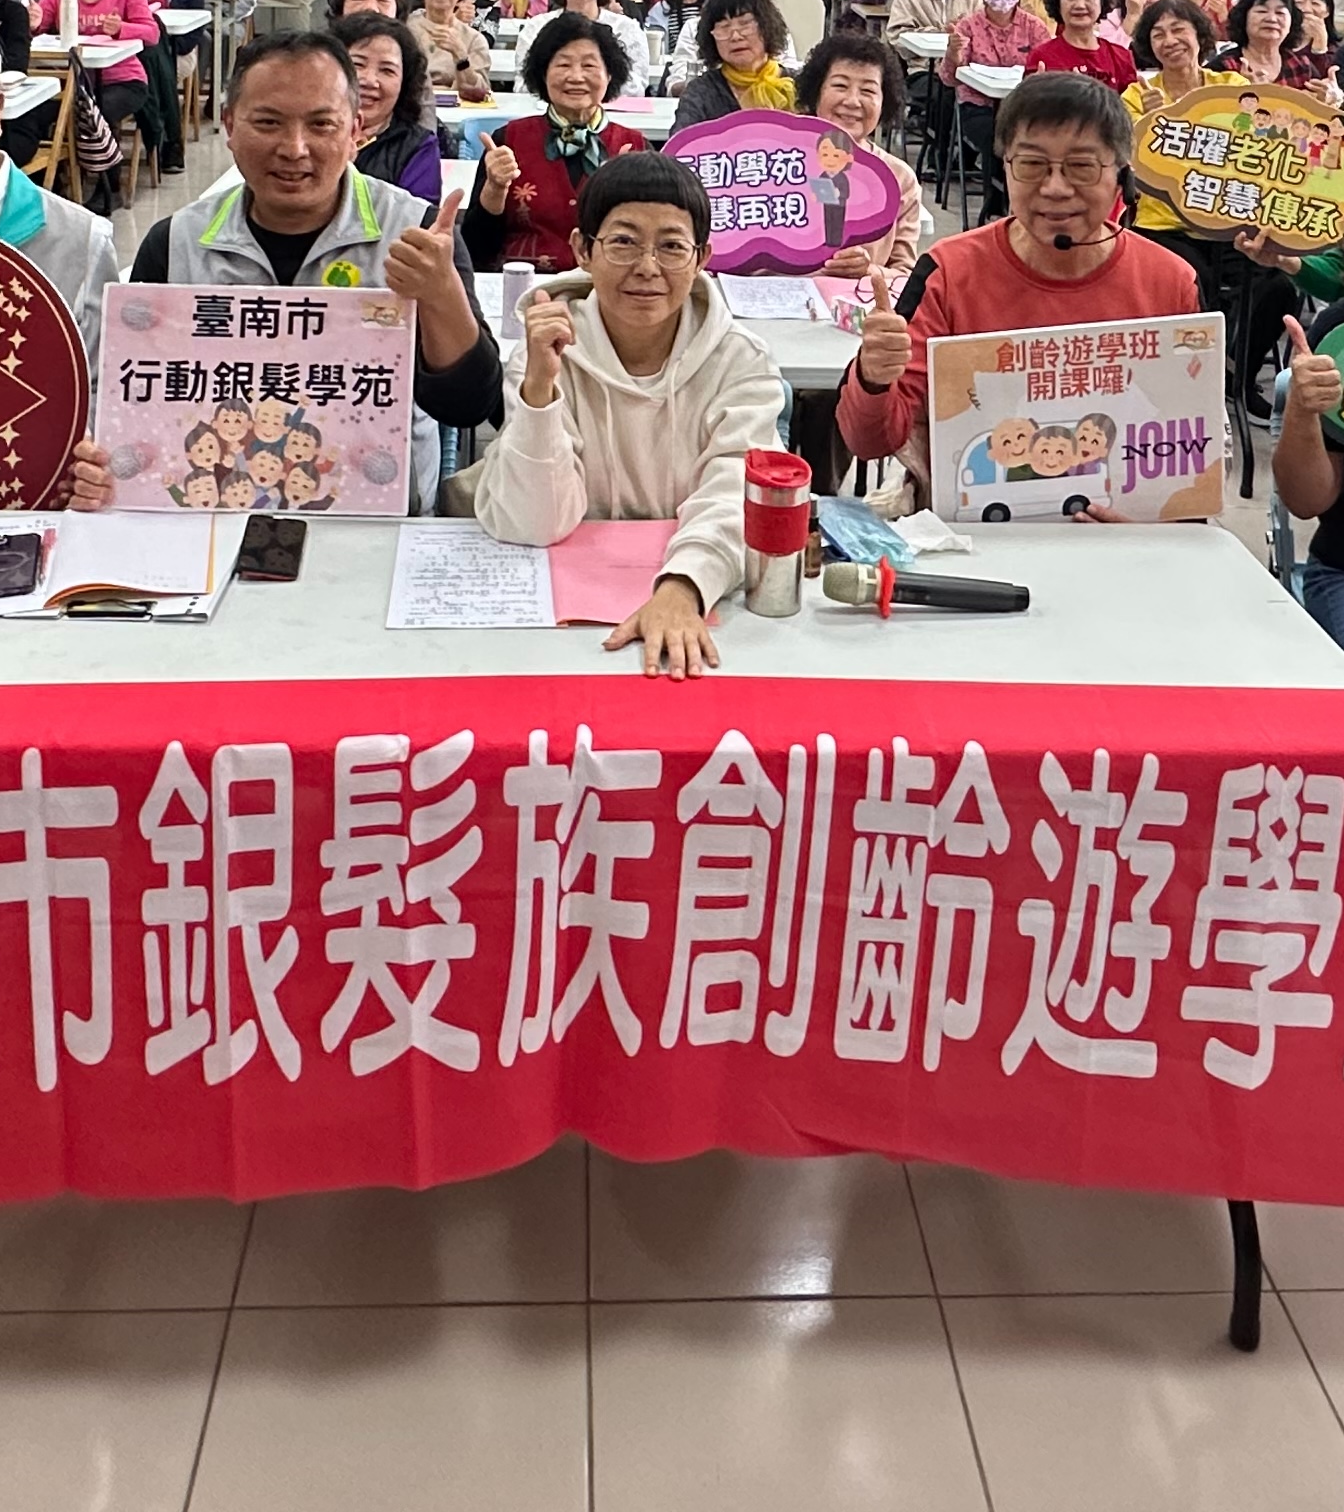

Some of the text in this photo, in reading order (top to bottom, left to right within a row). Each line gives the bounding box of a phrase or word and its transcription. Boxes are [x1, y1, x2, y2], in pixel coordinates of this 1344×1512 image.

[1148, 115, 1308, 185] 活躍老化
[1183, 169, 1343, 239] 智慧傳承
[191, 294, 328, 340] 臺南市
[996, 329, 1161, 374] 創齡遊學班
[119, 358, 395, 409] 行動銀髮學苑
[1121, 437, 1212, 461] NOW
[1121, 416, 1206, 494] JOIN
